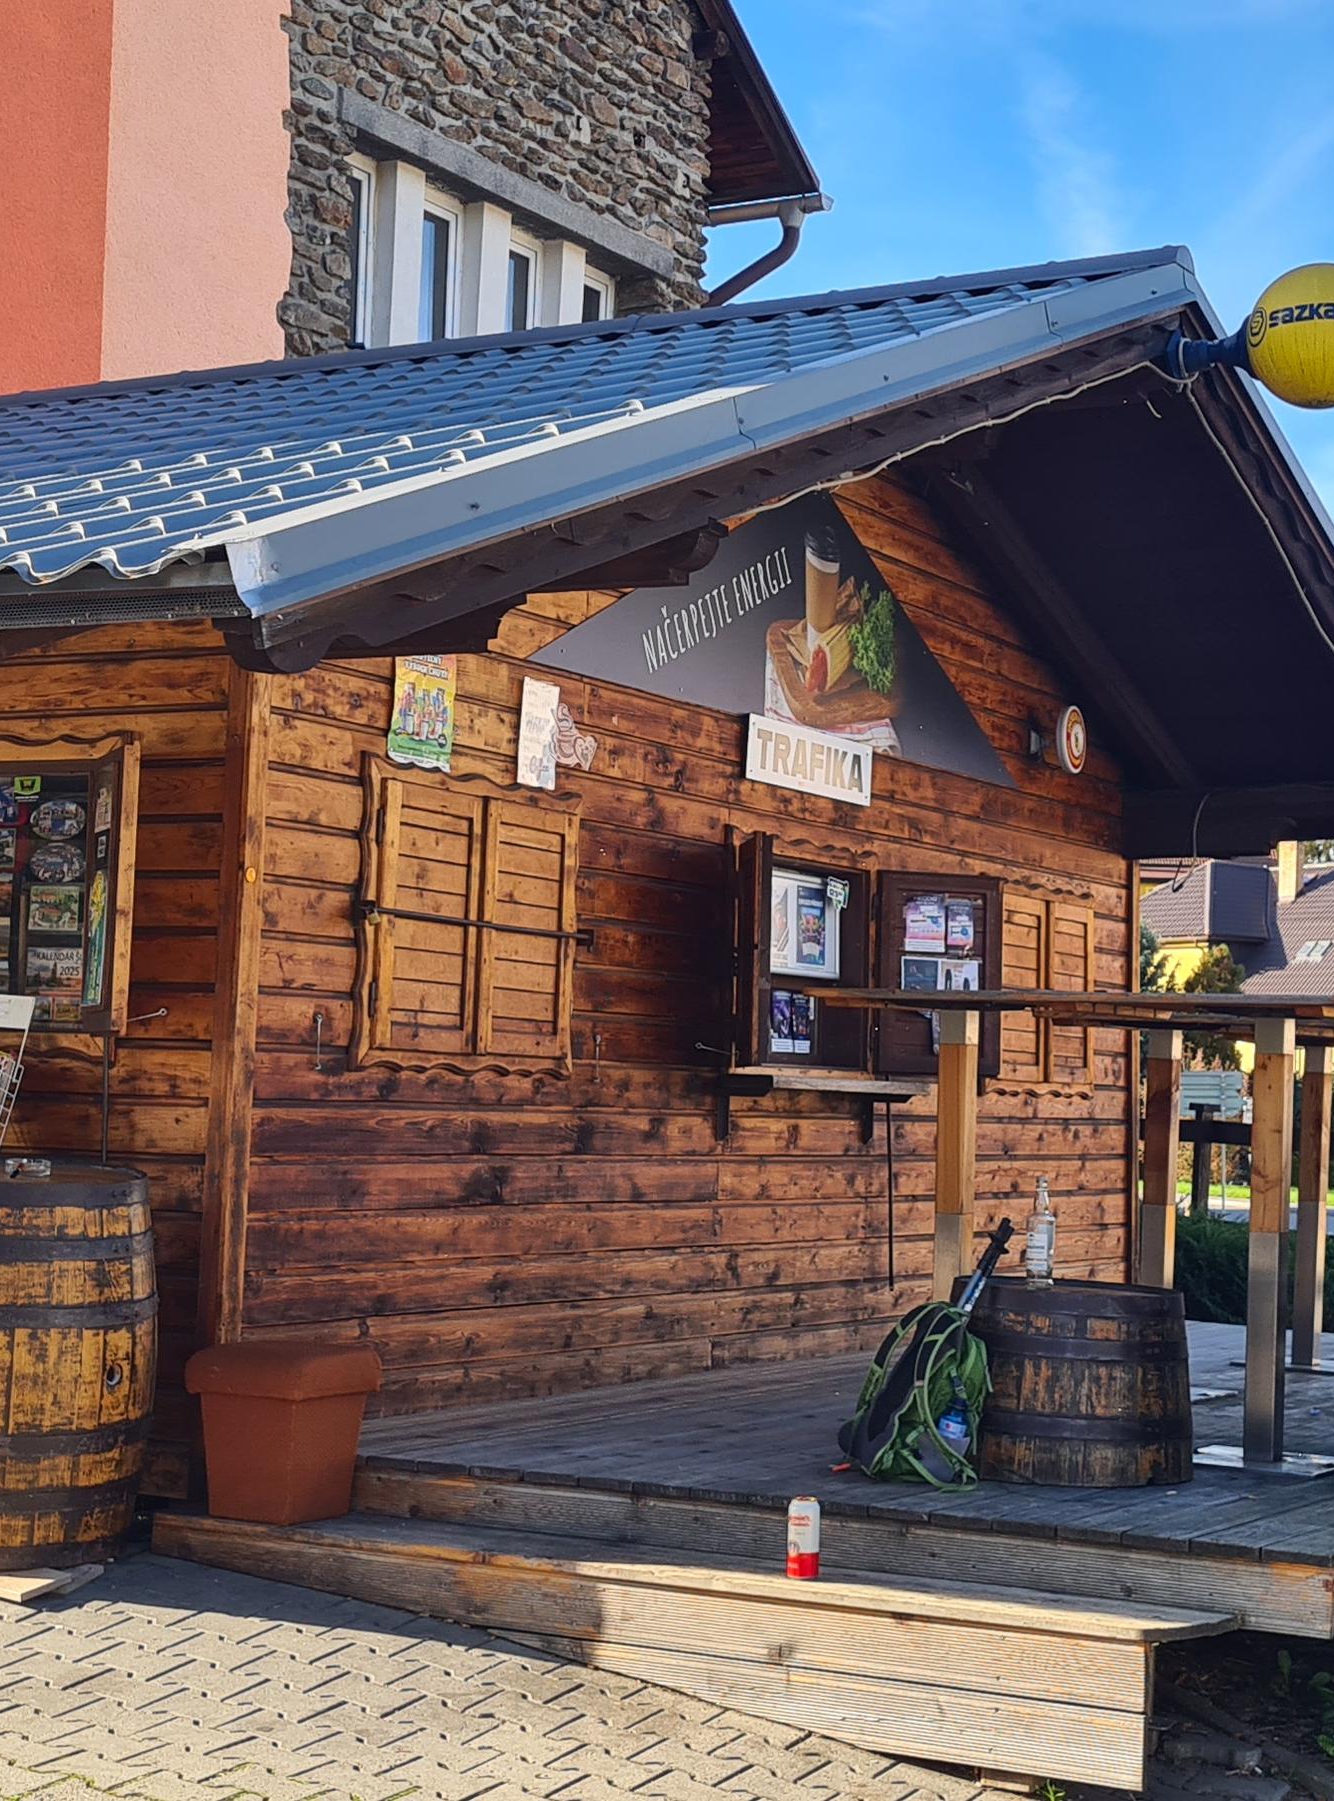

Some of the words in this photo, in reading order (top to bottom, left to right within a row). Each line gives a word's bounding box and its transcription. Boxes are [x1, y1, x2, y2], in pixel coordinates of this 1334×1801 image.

[642, 585, 732, 674] NAČERPEJTE
[732, 547, 792, 616] ENERGII
[757, 728, 863, 793] TRAFIKA
[59, 966, 80, 977] 2025
